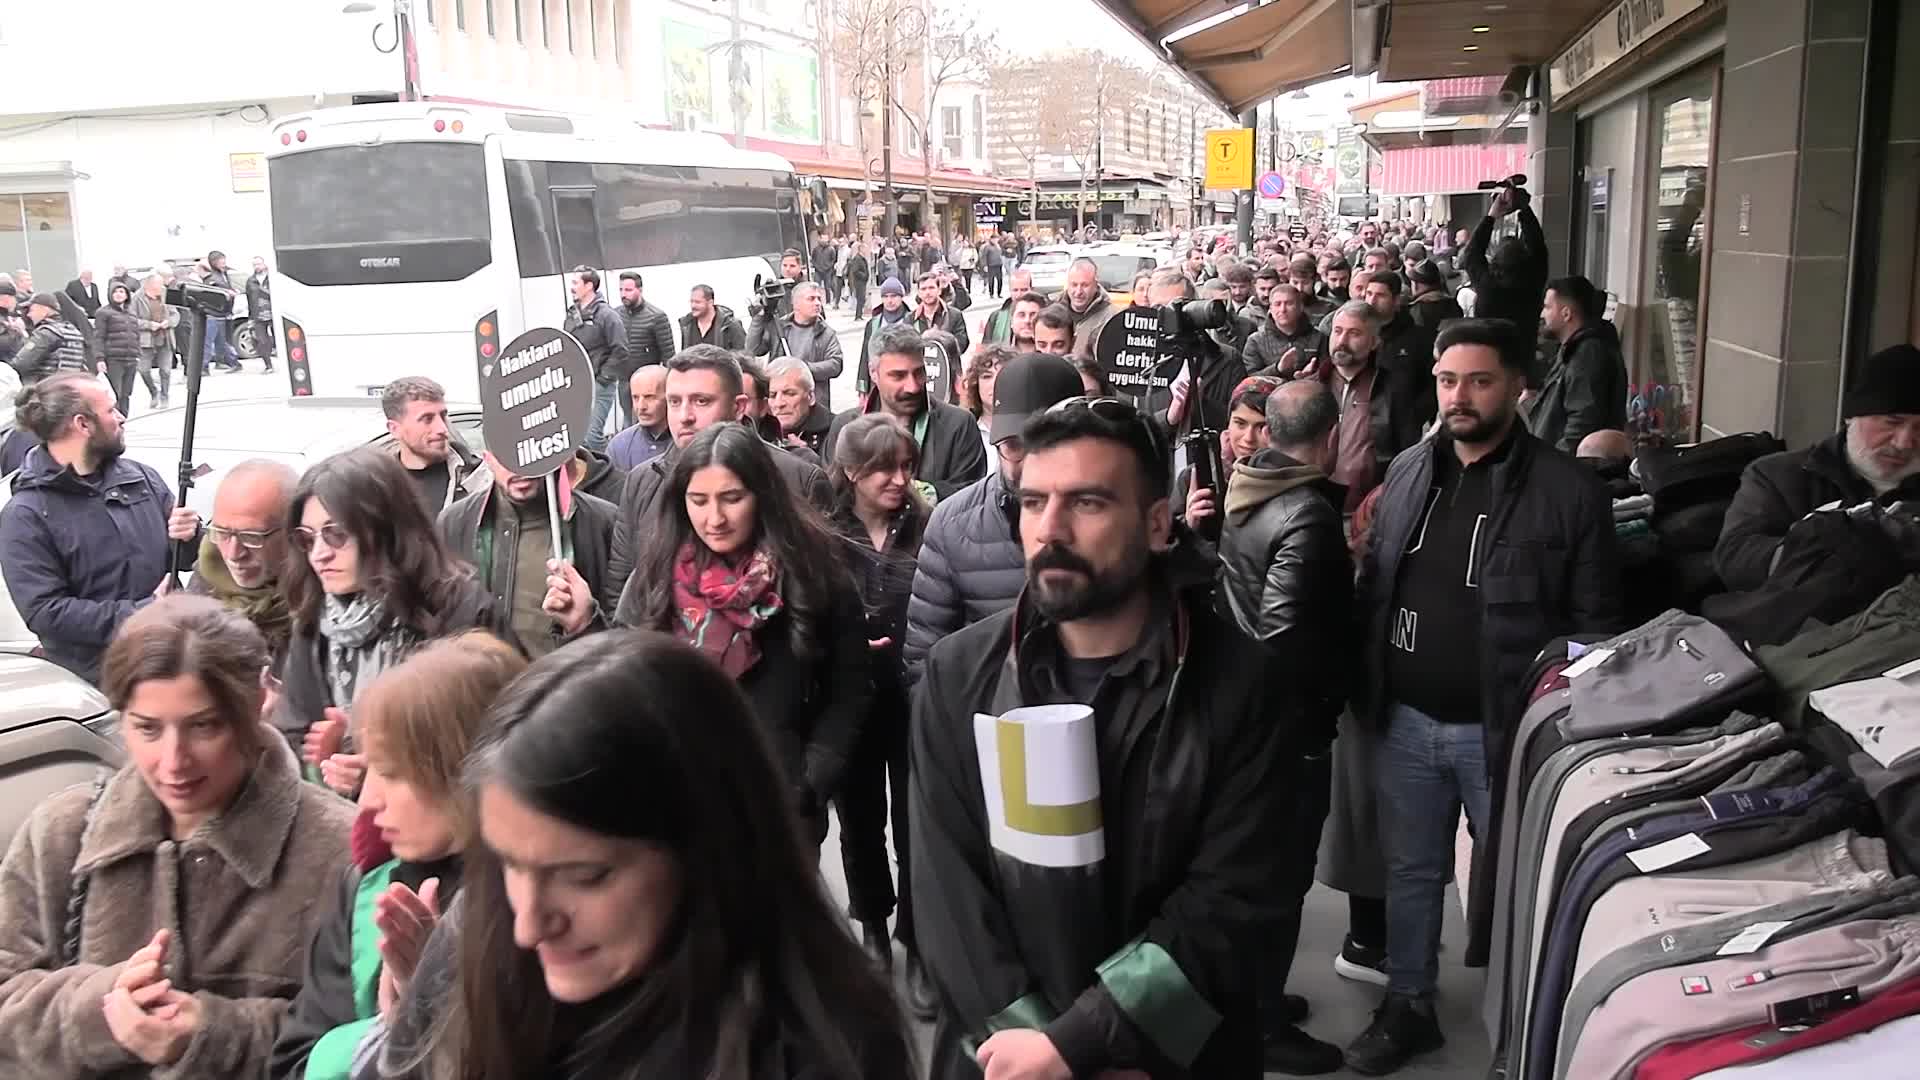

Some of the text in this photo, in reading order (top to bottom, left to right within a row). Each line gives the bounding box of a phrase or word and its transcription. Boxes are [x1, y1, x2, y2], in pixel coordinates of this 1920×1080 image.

[360, 257, 400, 268] OTOKAR
[1124, 312, 1162, 331] Umu
[500, 367, 572, 410] umudu,
[521, 401, 558, 431] umut
[517, 423, 570, 467] ilkesi
